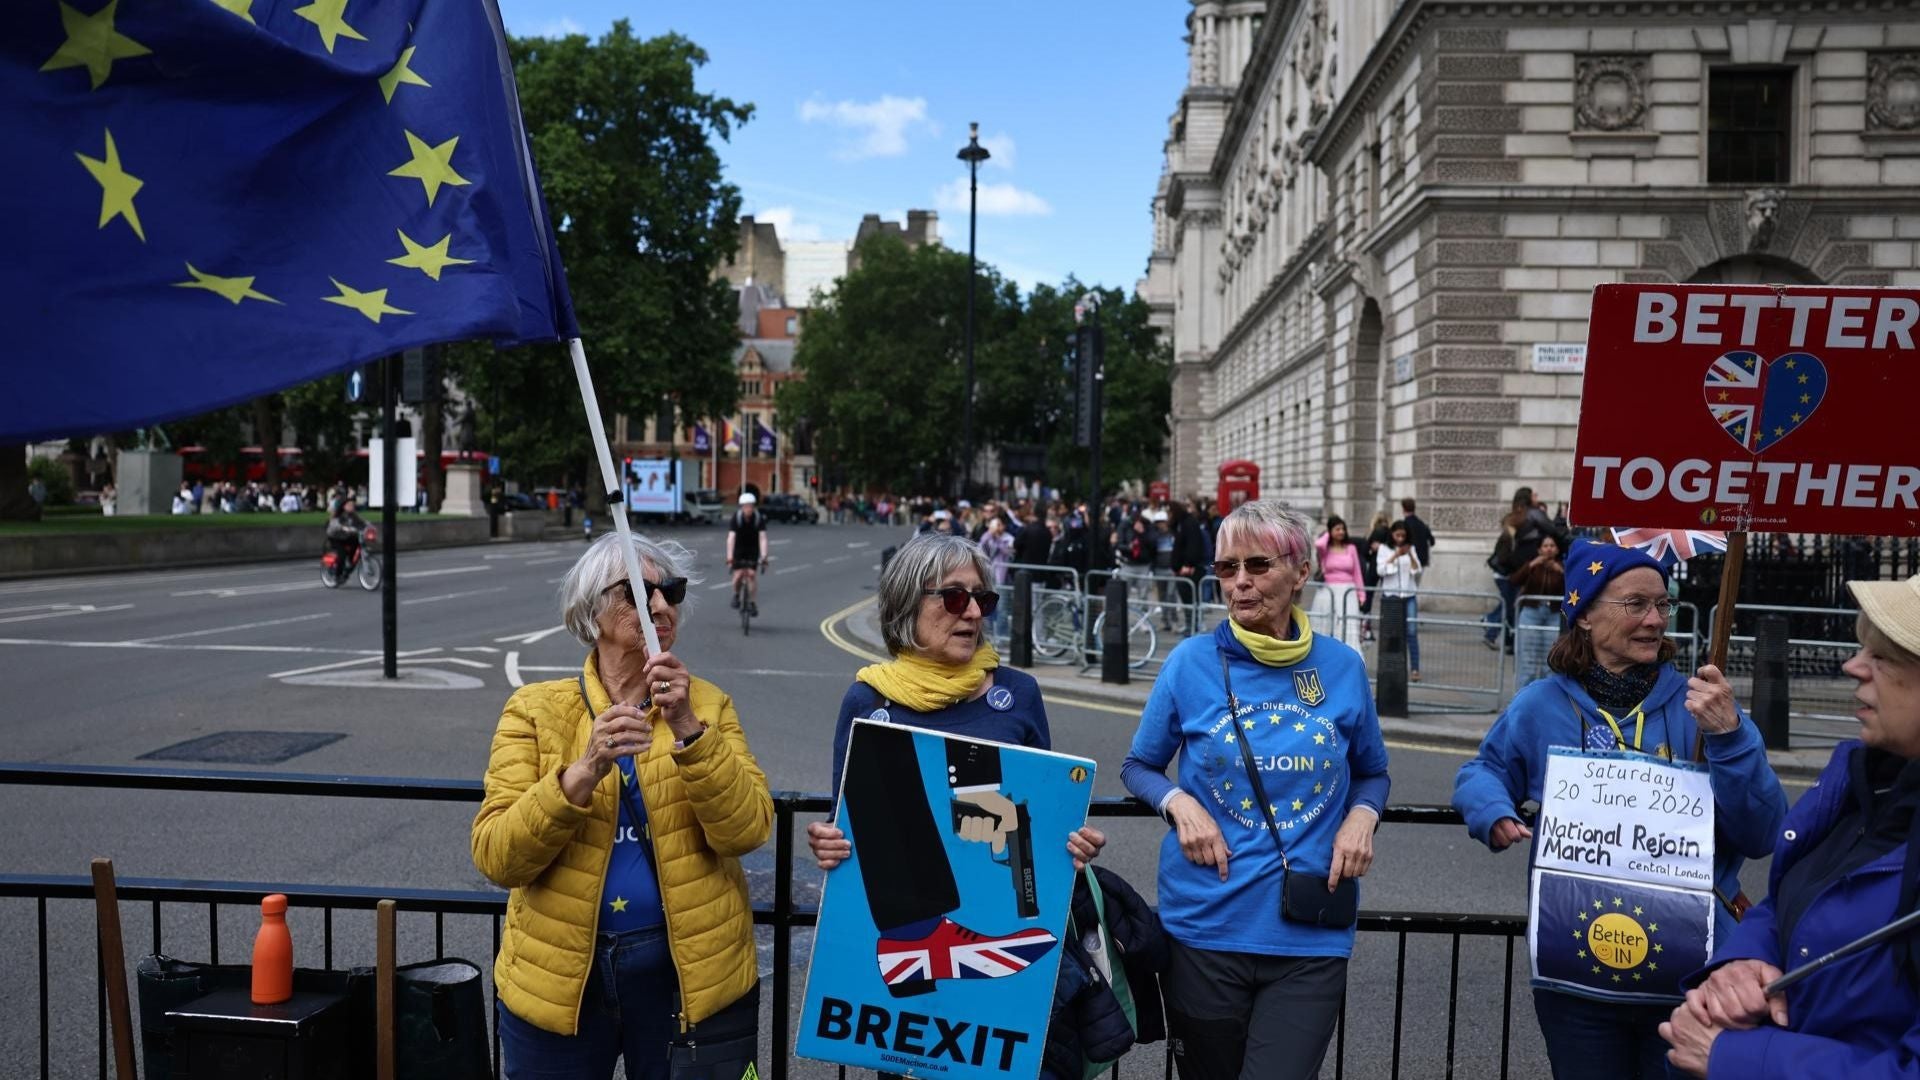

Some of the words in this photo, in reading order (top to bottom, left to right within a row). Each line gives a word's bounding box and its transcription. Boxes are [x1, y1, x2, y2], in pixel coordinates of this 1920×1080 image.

[1633, 292, 1920, 349] BETTER
[1582, 456, 1920, 509] TOGETHER
[1262, 702, 1311, 719] DIVERSITY
[1584, 762, 1675, 792] Saturday
[1553, 780, 1580, 801] 20
[1592, 783, 1638, 808] June
[1648, 790, 1704, 818] 2026
[1228, 808, 1254, 828] UNITY
[1260, 820, 1294, 830] PEAE
[1301, 803, 1324, 824] LOVE
[1542, 816, 1622, 847] National
[1632, 824, 1700, 858] Rejoin
[1542, 837, 1611, 867] March
[1023, 867, 1035, 905] BREXIT
[1674, 866, 1711, 881] London
[1593, 923, 1645, 947] Better
[1615, 947, 1631, 964] IN
[816, 996, 1029, 1072] BREXIT
[880, 1053, 949, 1073] SODEMaction.co.uk
